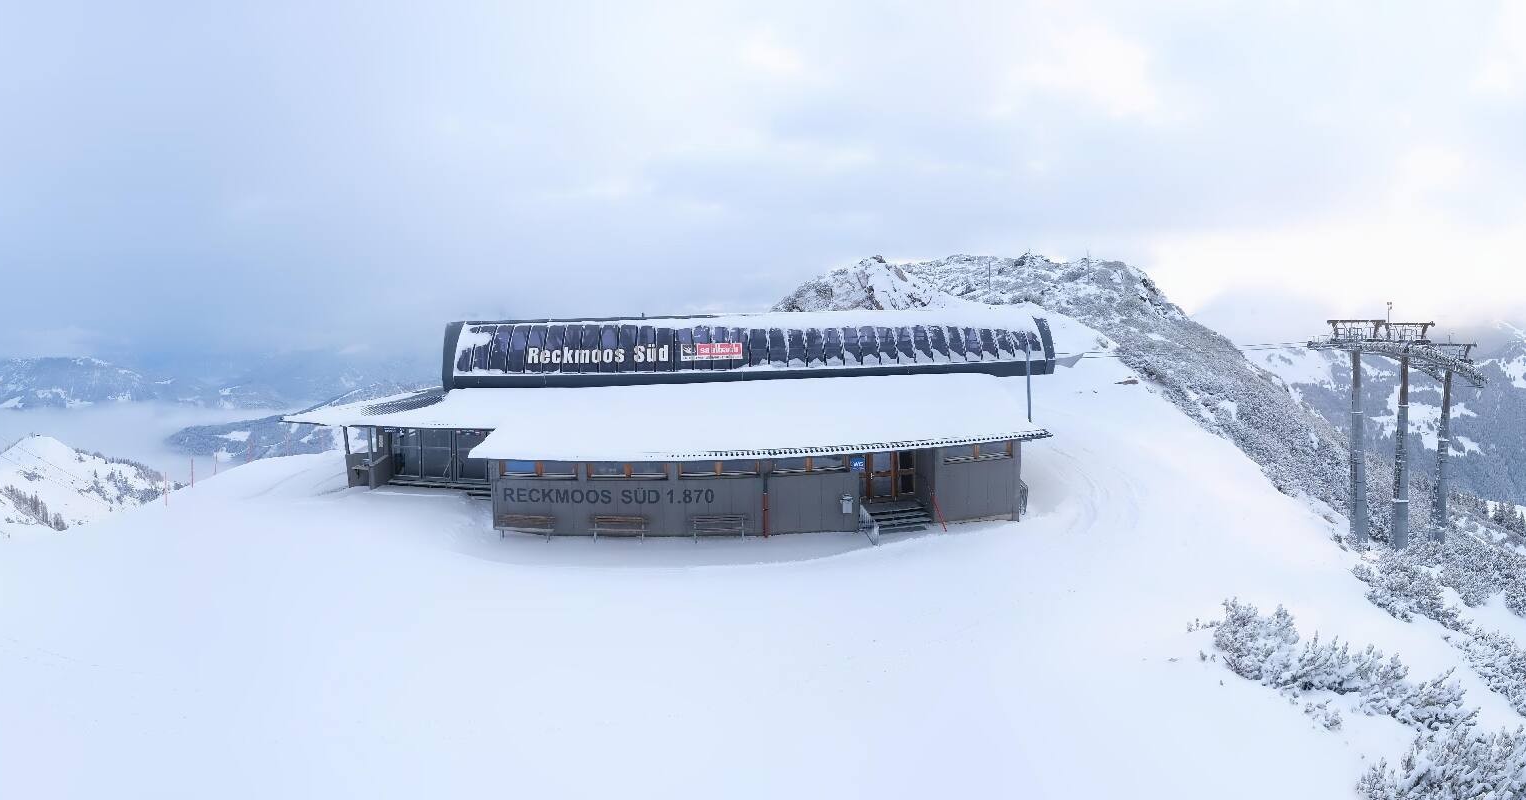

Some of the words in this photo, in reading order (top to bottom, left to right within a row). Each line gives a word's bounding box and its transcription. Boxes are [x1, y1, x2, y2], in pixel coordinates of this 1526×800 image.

[527, 347, 625, 363] Reckmoos
[633, 343, 669, 362] Süd
[503, 488, 612, 504] RECKMOOS
[621, 487, 660, 505] SÜD
[666, 488, 715, 504] 1.870
